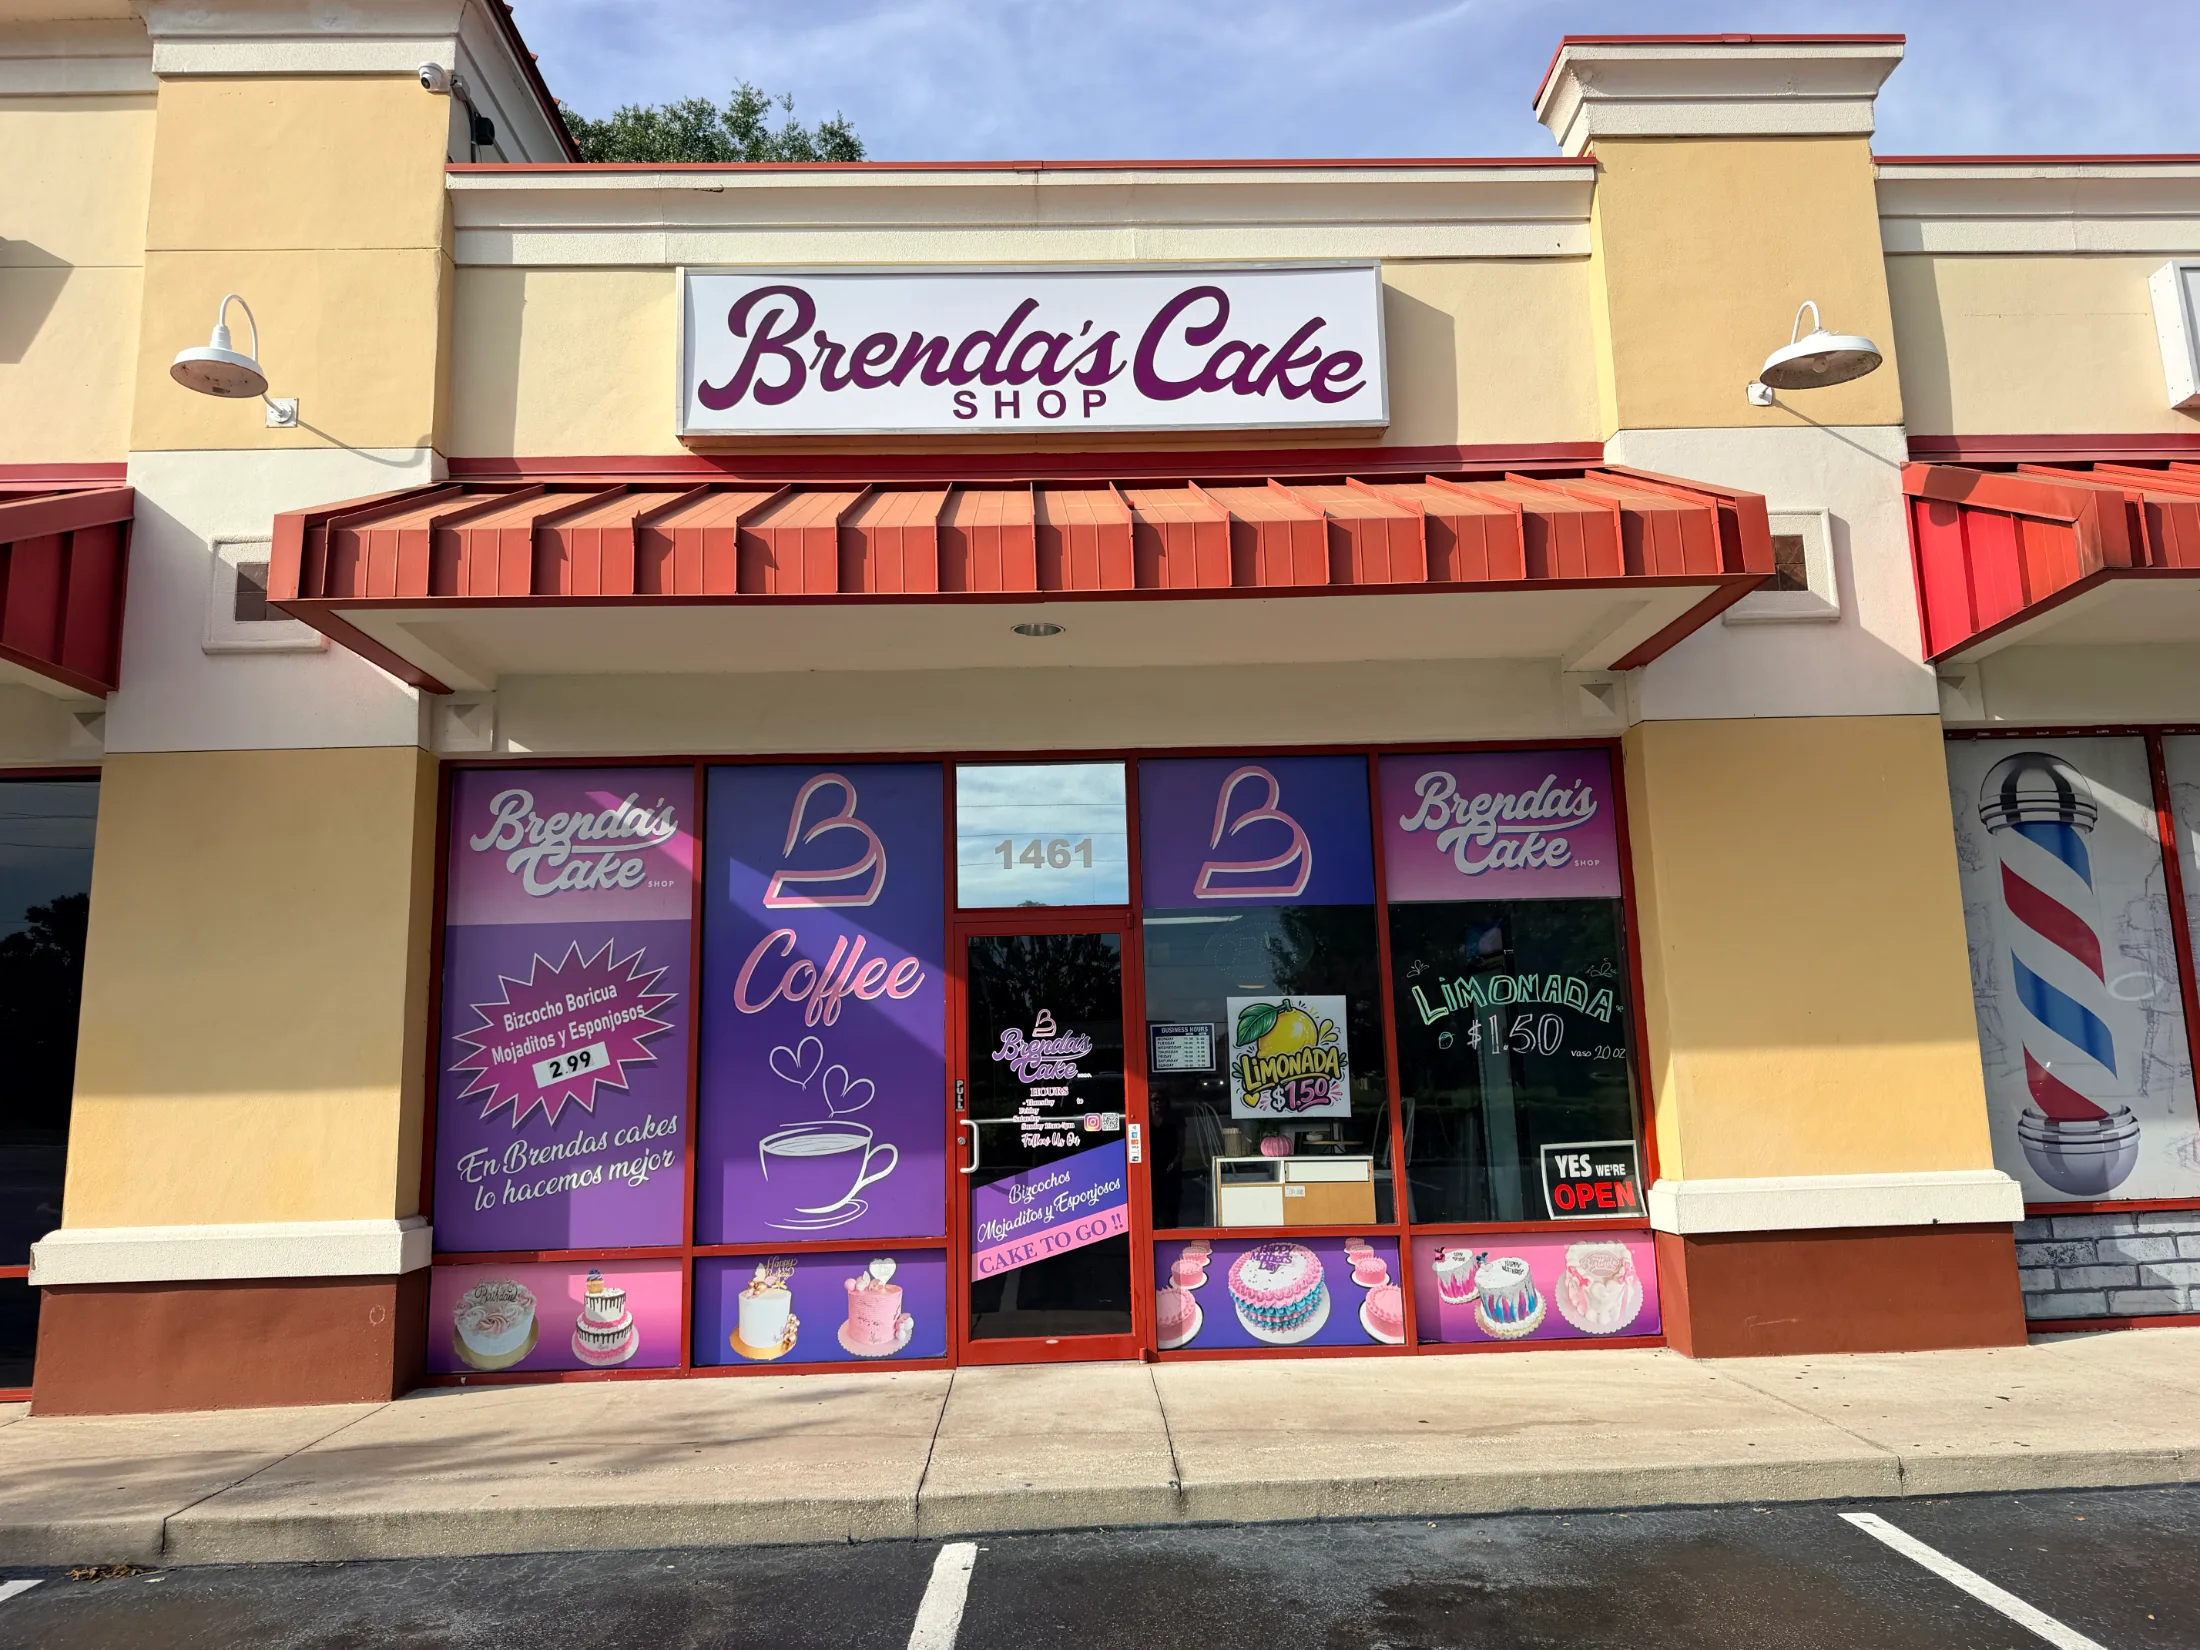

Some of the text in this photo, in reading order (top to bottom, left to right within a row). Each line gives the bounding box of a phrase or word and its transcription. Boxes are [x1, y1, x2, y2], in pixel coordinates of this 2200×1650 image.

[697, 285, 1368, 411] Brenda's Cake
[952, 390, 1108, 420] SHOP
[1399, 771, 1598, 833] Brenda's
[469, 788, 679, 853] Brenda's
[994, 838, 1093, 870] 1461
[1436, 820, 1572, 875] Cake
[1574, 859, 1601, 868] SHOP
[506, 840, 647, 897] Cake
[647, 880, 675, 889] SHOP
[733, 928, 926, 1027] Coffee
[502, 983, 618, 1033] Bizcocho Boricua
[491, 1003, 646, 1066] Mojaditos y Esponjosos
[992, 1027, 1093, 1063] Brenda's
[1161, 1026, 1189, 1034] BUSINESS
[1189, 1025, 1209, 1033] HOURS
[1467, 1014, 1564, 1056] $1.50
[549, 1050, 592, 1080] 2.99
[1010, 1054, 1079, 1083] Cake
[1570, 1049, 1592, 1057] vaso
[956, 1079, 965, 1110] PULL
[1030, 1086, 1069, 1097] HOURS
[1270, 1078, 1330, 1113] $1.50
[457, 1114, 678, 1184] En Brendas cakes
[1554, 1154, 1626, 1178] YES WE'RE
[474, 1148, 676, 1212] lo hacemos mejor
[1009, 1170, 1071, 1205] Bizcochos
[1554, 1180, 1636, 1210] OPEN
[977, 1178, 1121, 1243] Mojaditos y Esponjosos
[979, 1242, 1038, 1274] CAKE
[1040, 1231, 1072, 1253] TO
[1075, 1219, 1107, 1242] GO
